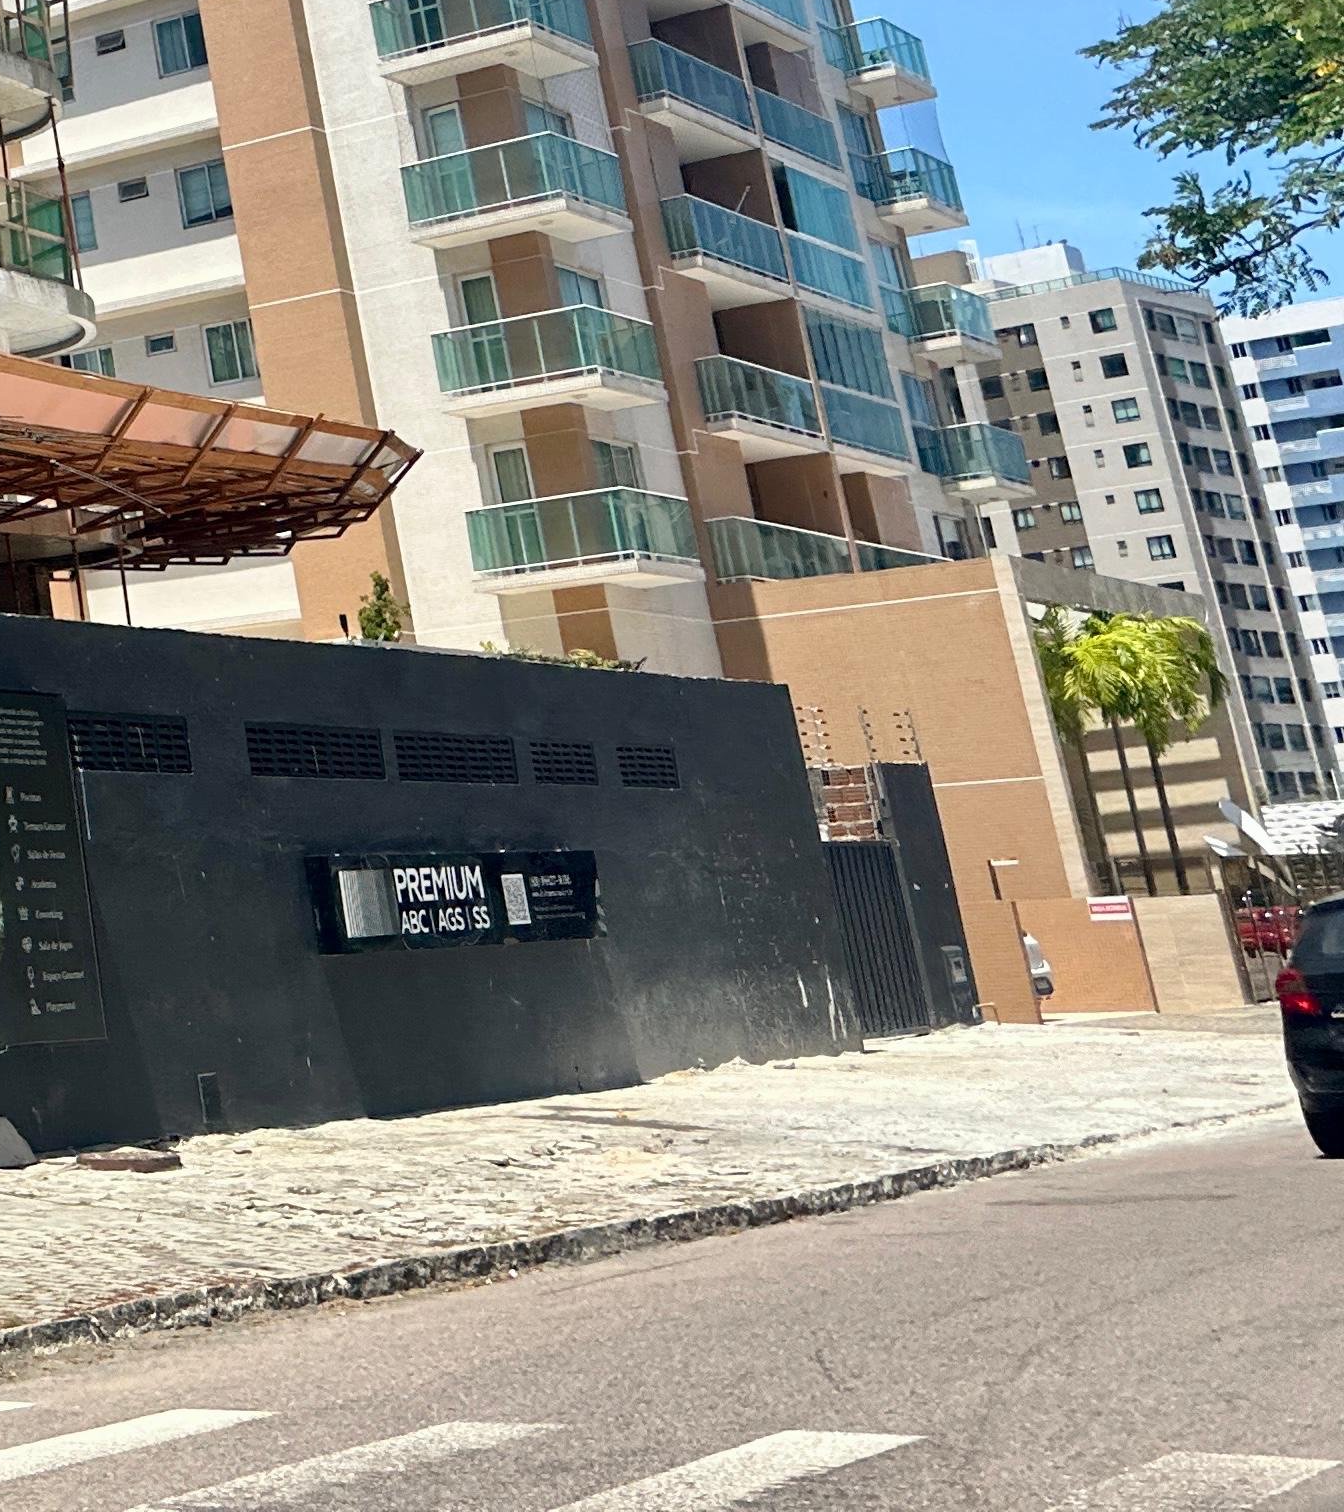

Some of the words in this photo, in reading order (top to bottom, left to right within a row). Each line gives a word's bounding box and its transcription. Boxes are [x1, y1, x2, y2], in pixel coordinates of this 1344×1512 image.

[393, 865, 485, 903] PREMIUM
[402, 909, 430, 934] ABC
[438, 908, 464, 931] AGS
[473, 905, 491, 929] SS
